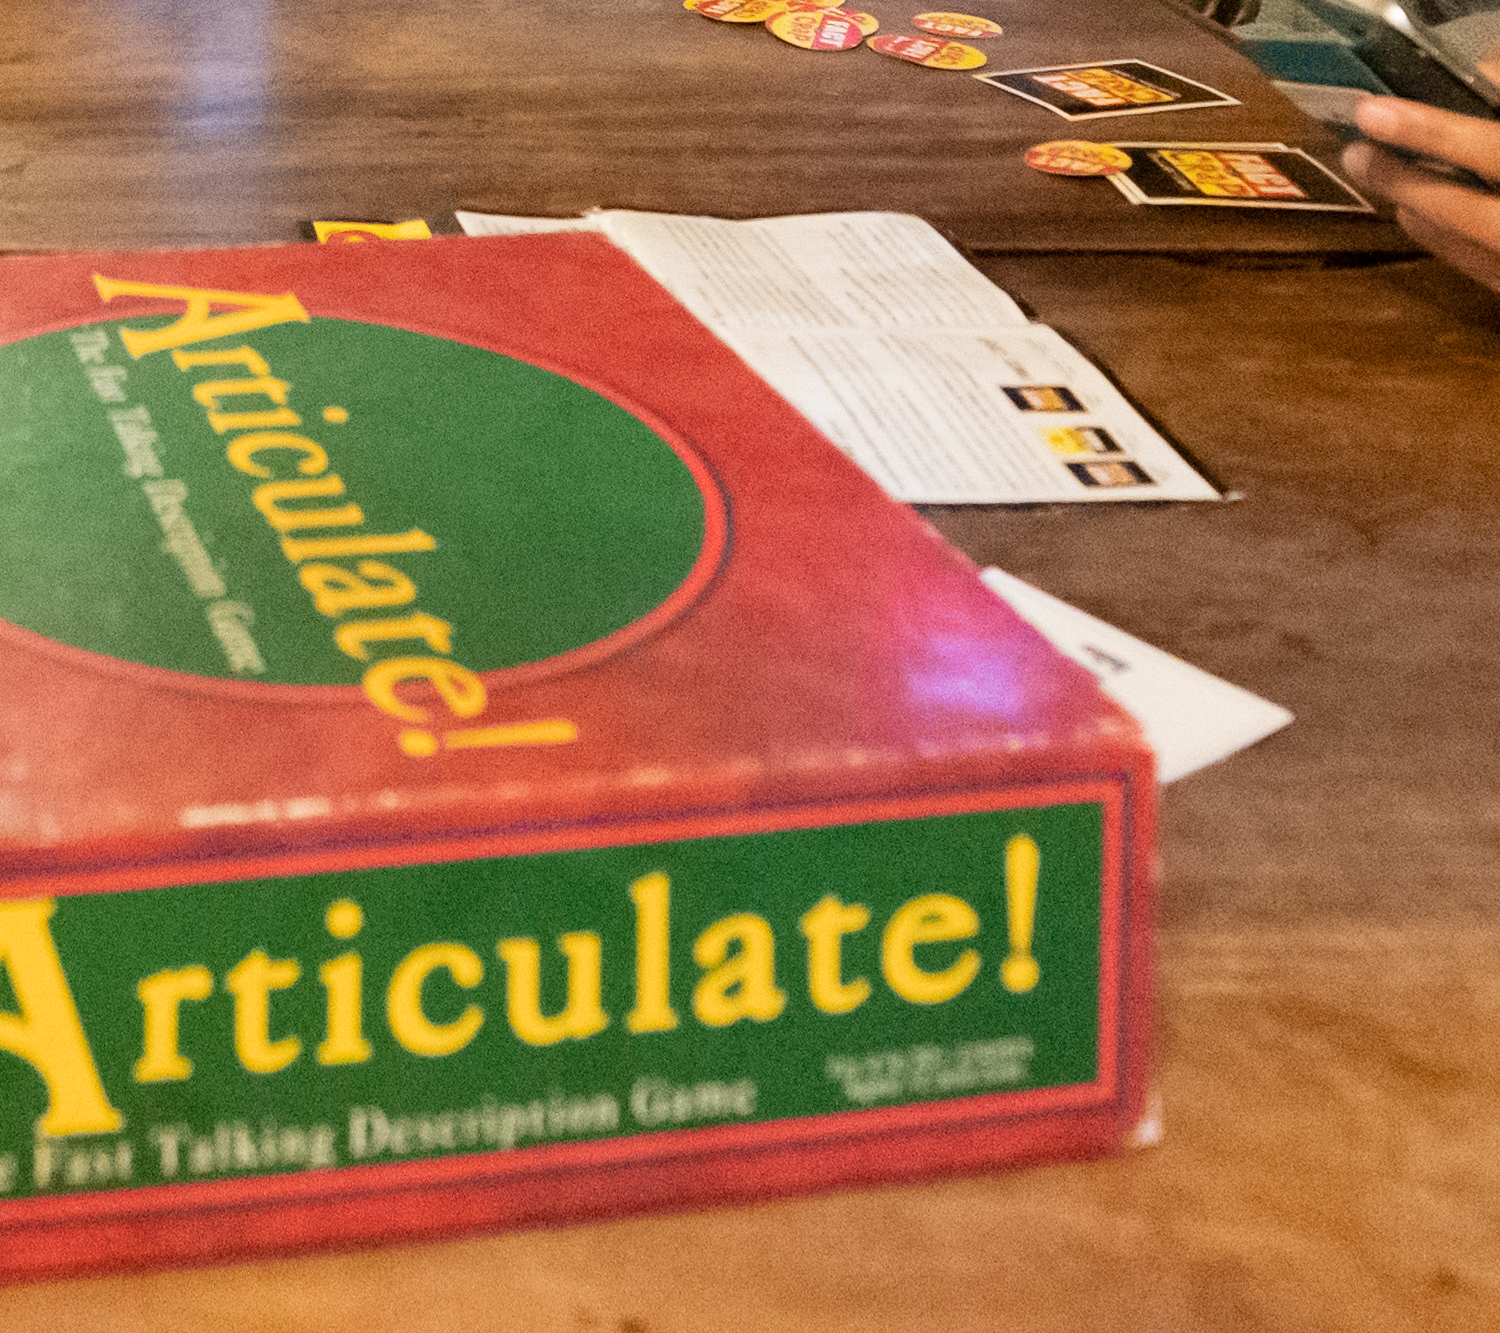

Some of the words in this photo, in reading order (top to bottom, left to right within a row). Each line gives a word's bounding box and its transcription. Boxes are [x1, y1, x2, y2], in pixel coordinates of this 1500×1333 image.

[92, 272, 579, 758] Articulate!
[33, 1136, 133, 1193] Fast
[152, 1119, 337, 1180] Talking
[346, 1085, 620, 1159] Description
[627, 1076, 758, 1126] Game
